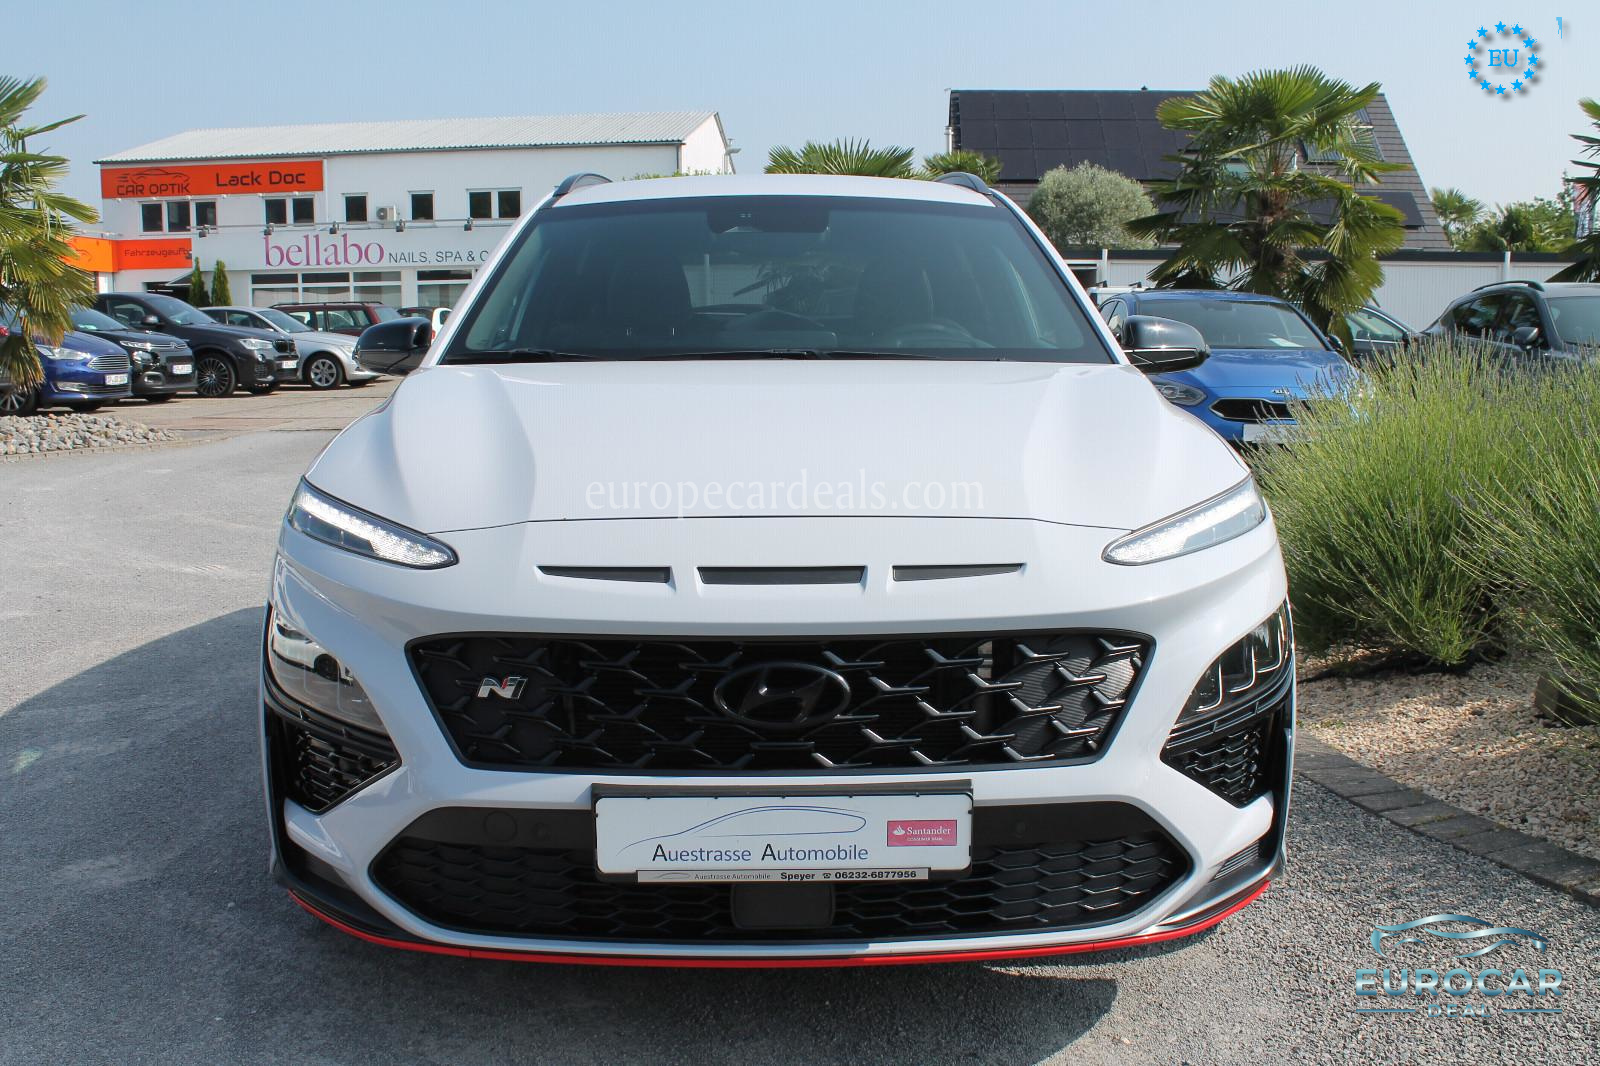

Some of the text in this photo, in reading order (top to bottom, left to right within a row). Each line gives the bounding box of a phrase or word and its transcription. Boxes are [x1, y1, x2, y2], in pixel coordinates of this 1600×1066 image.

[216, 170, 305, 187] Lack Doc
[117, 182, 190, 196] CAR OPTIK
[263, 233, 385, 267] bellabo
[388, 252, 431, 265] NAILS,
[435, 251, 462, 263] SPA
[466, 251, 475, 262] &
[906, 827, 951, 836] Santander
[652, 843, 869, 862] Auestrasse Automobile
[732, 872, 771, 880] Automobile
[780, 872, 815, 881] Speyer
[834, 871, 917, 880] 06232-6877956
